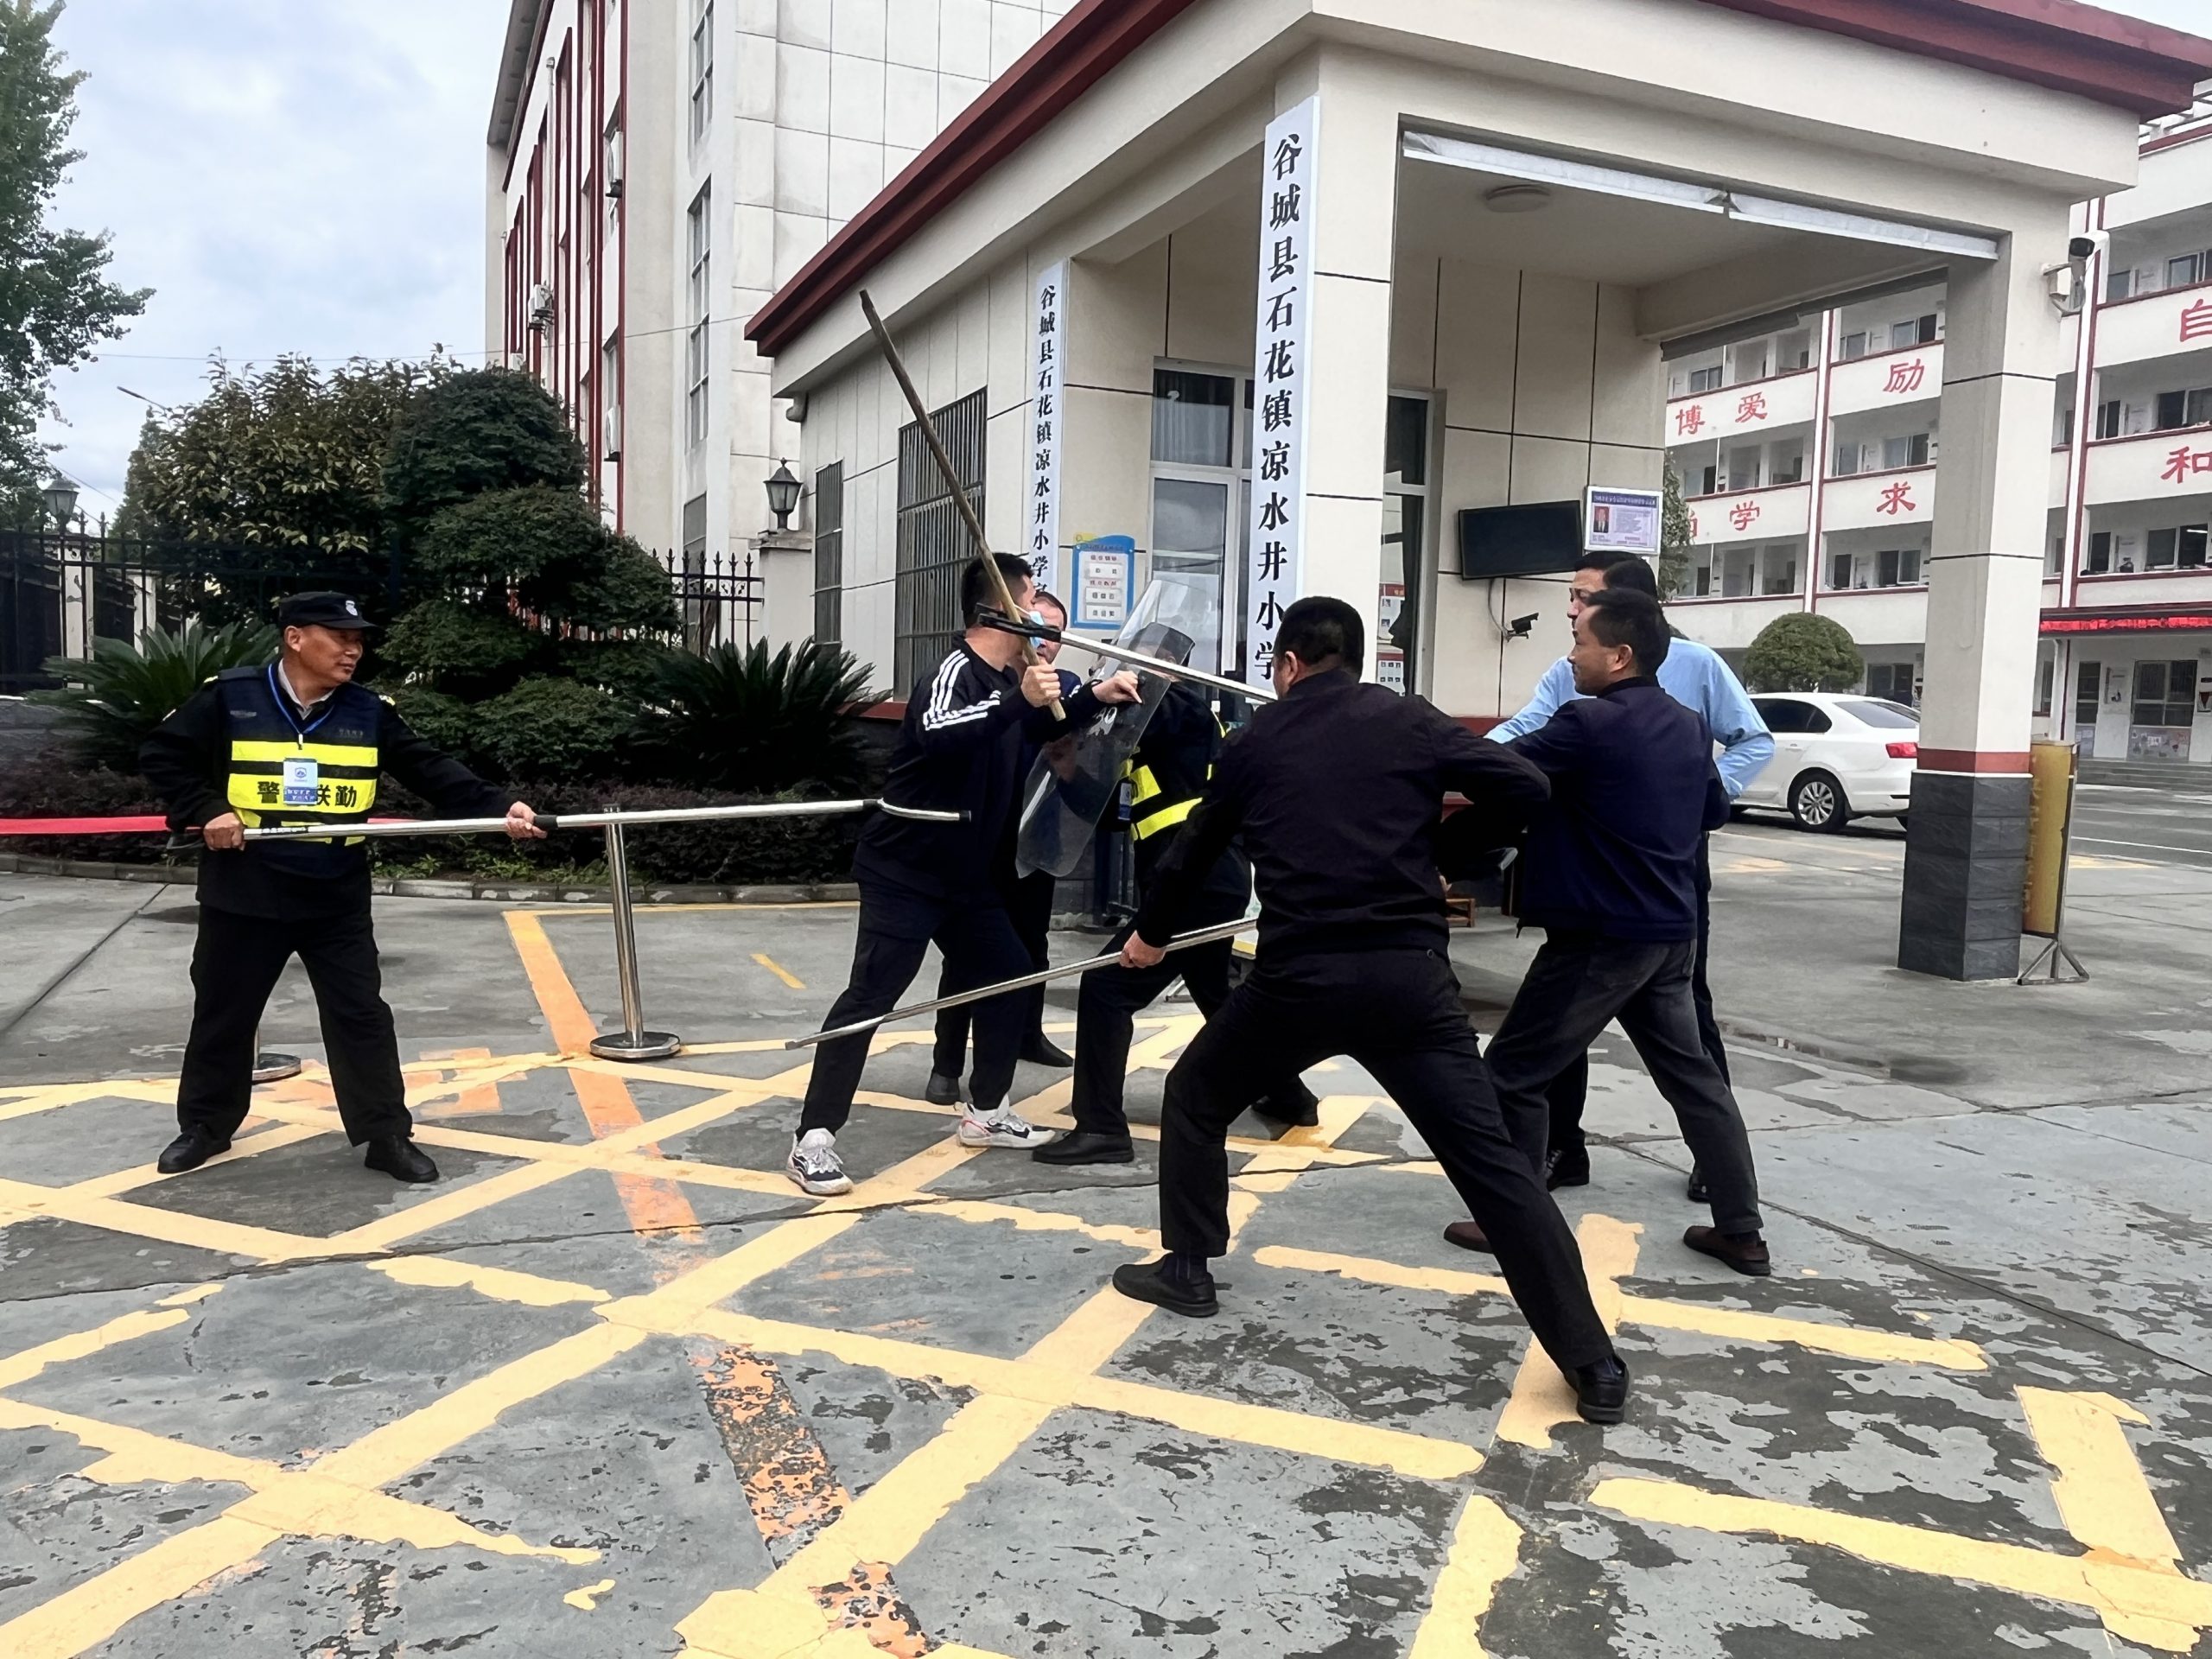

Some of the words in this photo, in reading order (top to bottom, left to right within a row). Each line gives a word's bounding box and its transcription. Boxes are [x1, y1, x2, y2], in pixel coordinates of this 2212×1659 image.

[1883, 359, 1925, 393] 励
[1254, 132, 1302, 680] 谷城县石花镇凉水井小学
[1675, 391, 1768, 435] 博爱
[1877, 483, 1916, 516] 求
